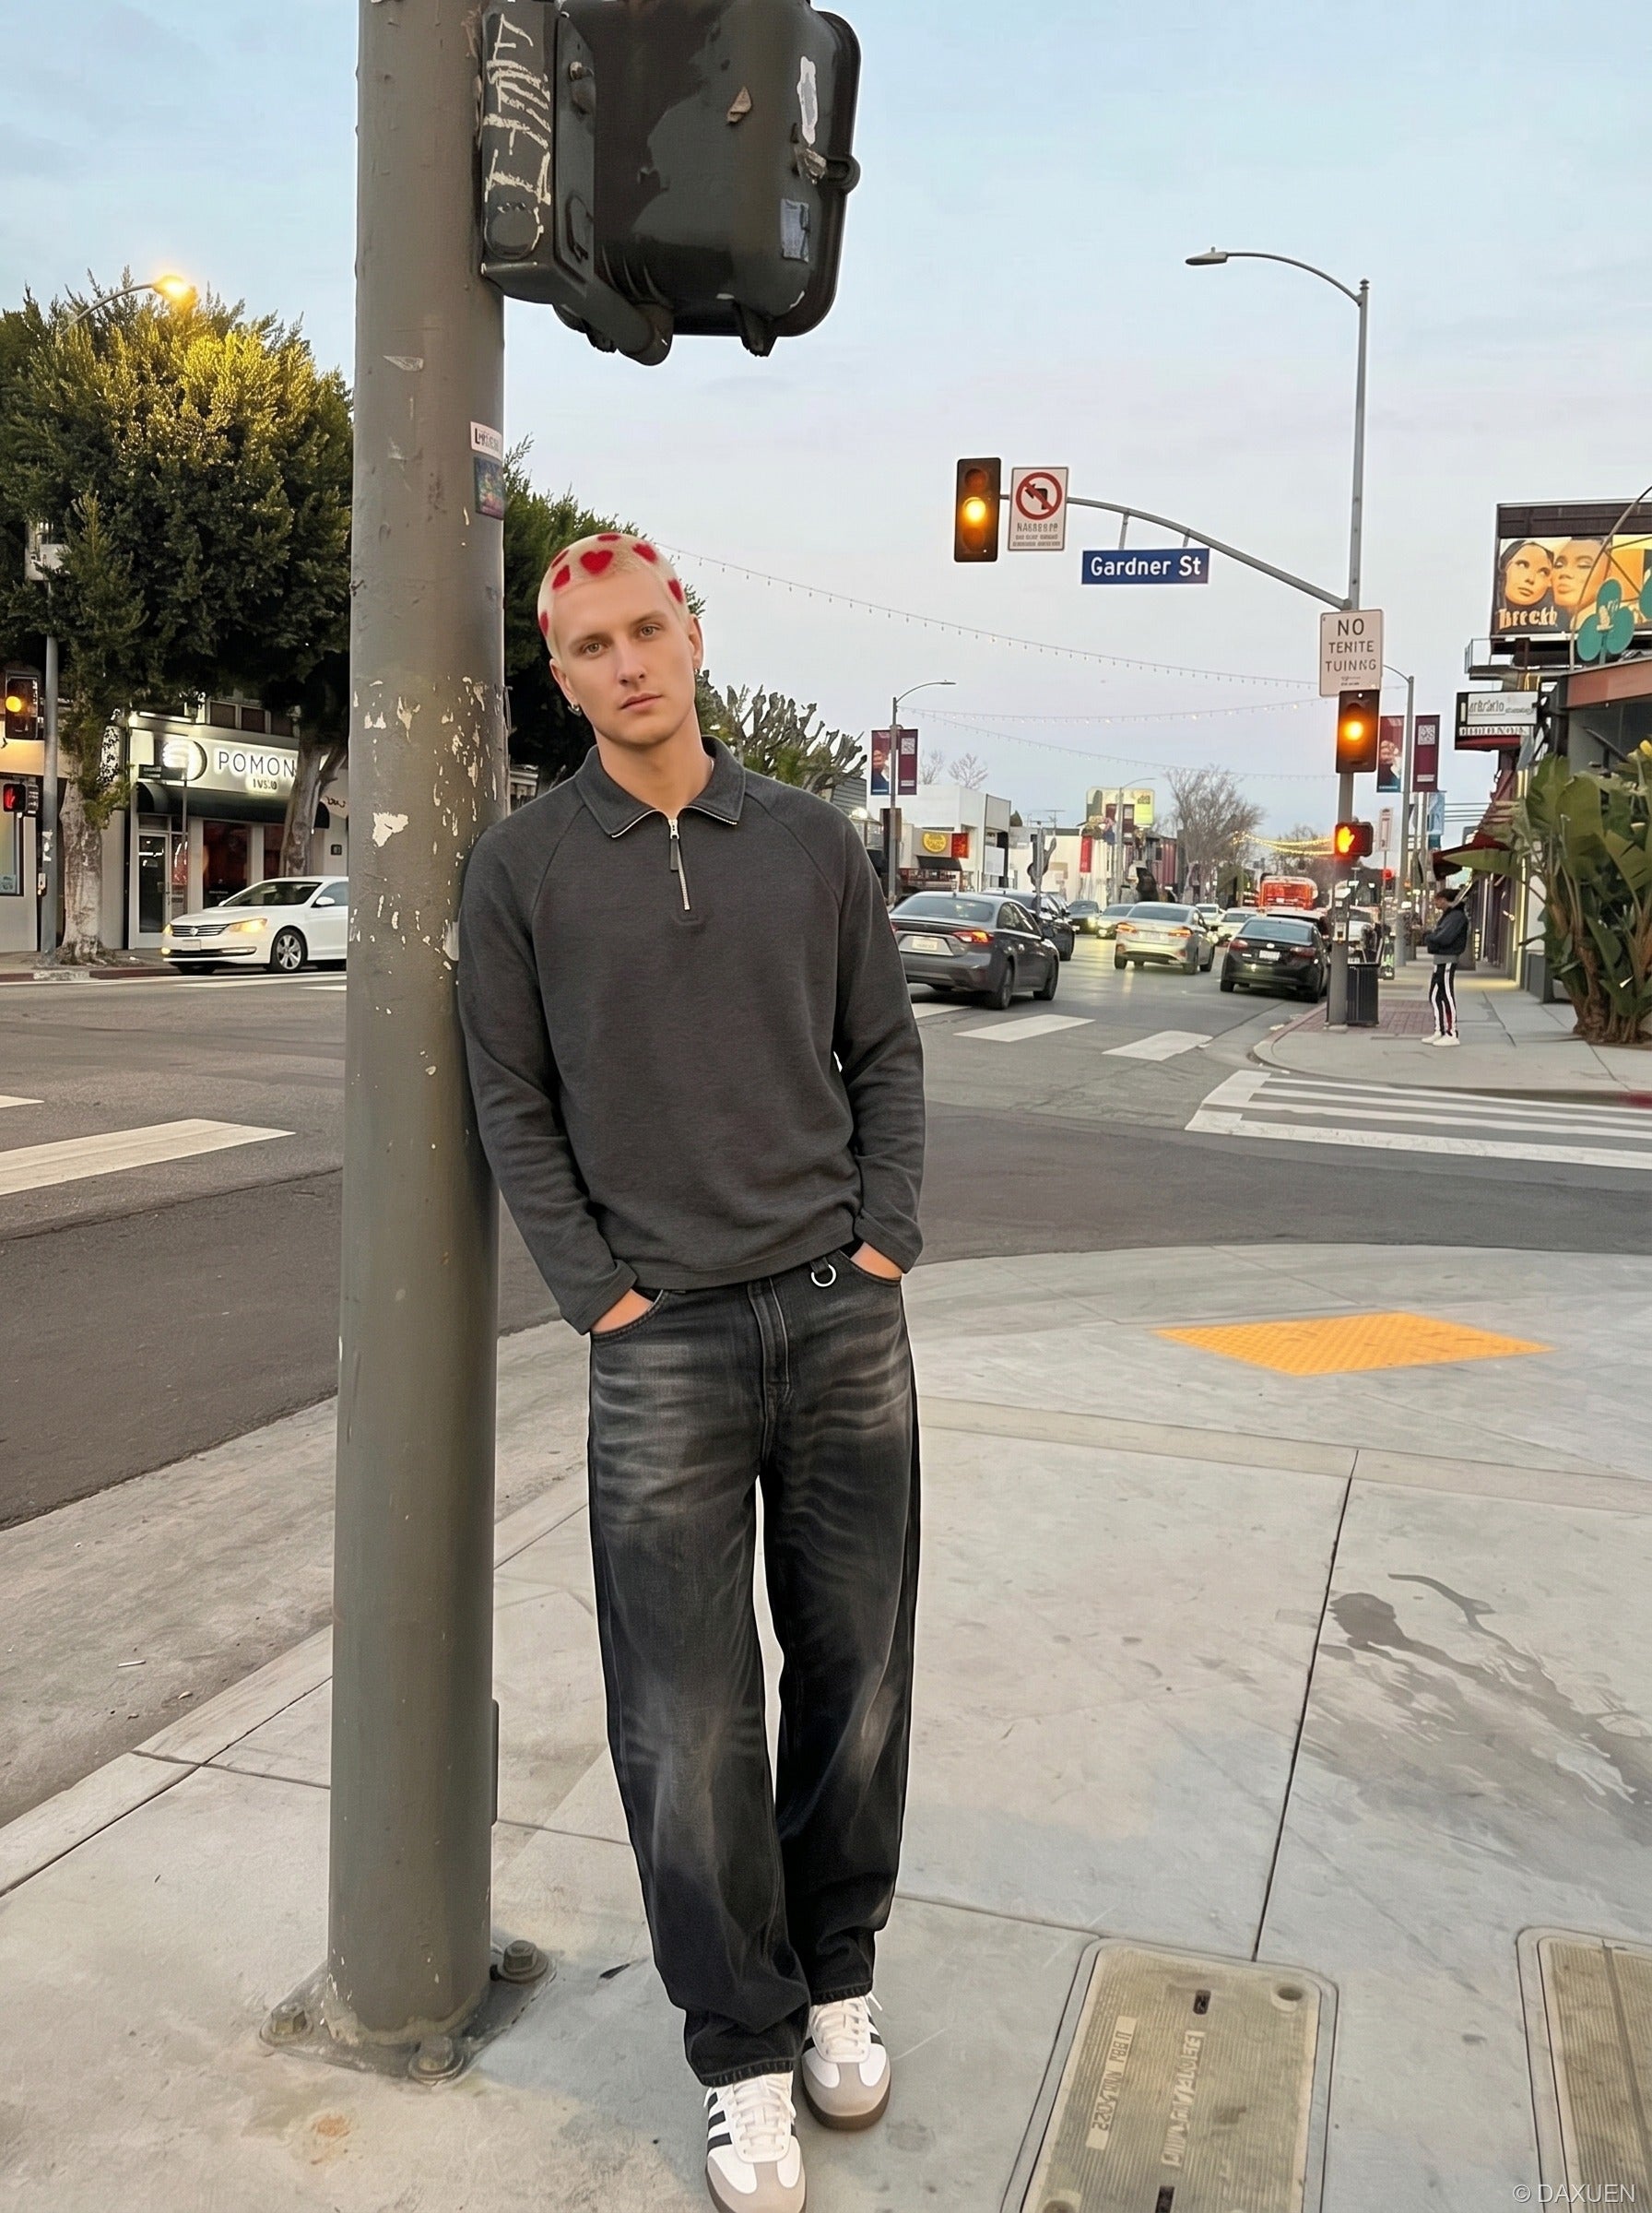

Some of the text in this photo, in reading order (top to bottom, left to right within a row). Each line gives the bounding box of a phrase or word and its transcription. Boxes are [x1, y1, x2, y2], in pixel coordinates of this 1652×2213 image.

[1091, 555, 1202, 576] Gardner St
[1337, 618, 1364, 636] NO
[218, 751, 297, 778] POMON
